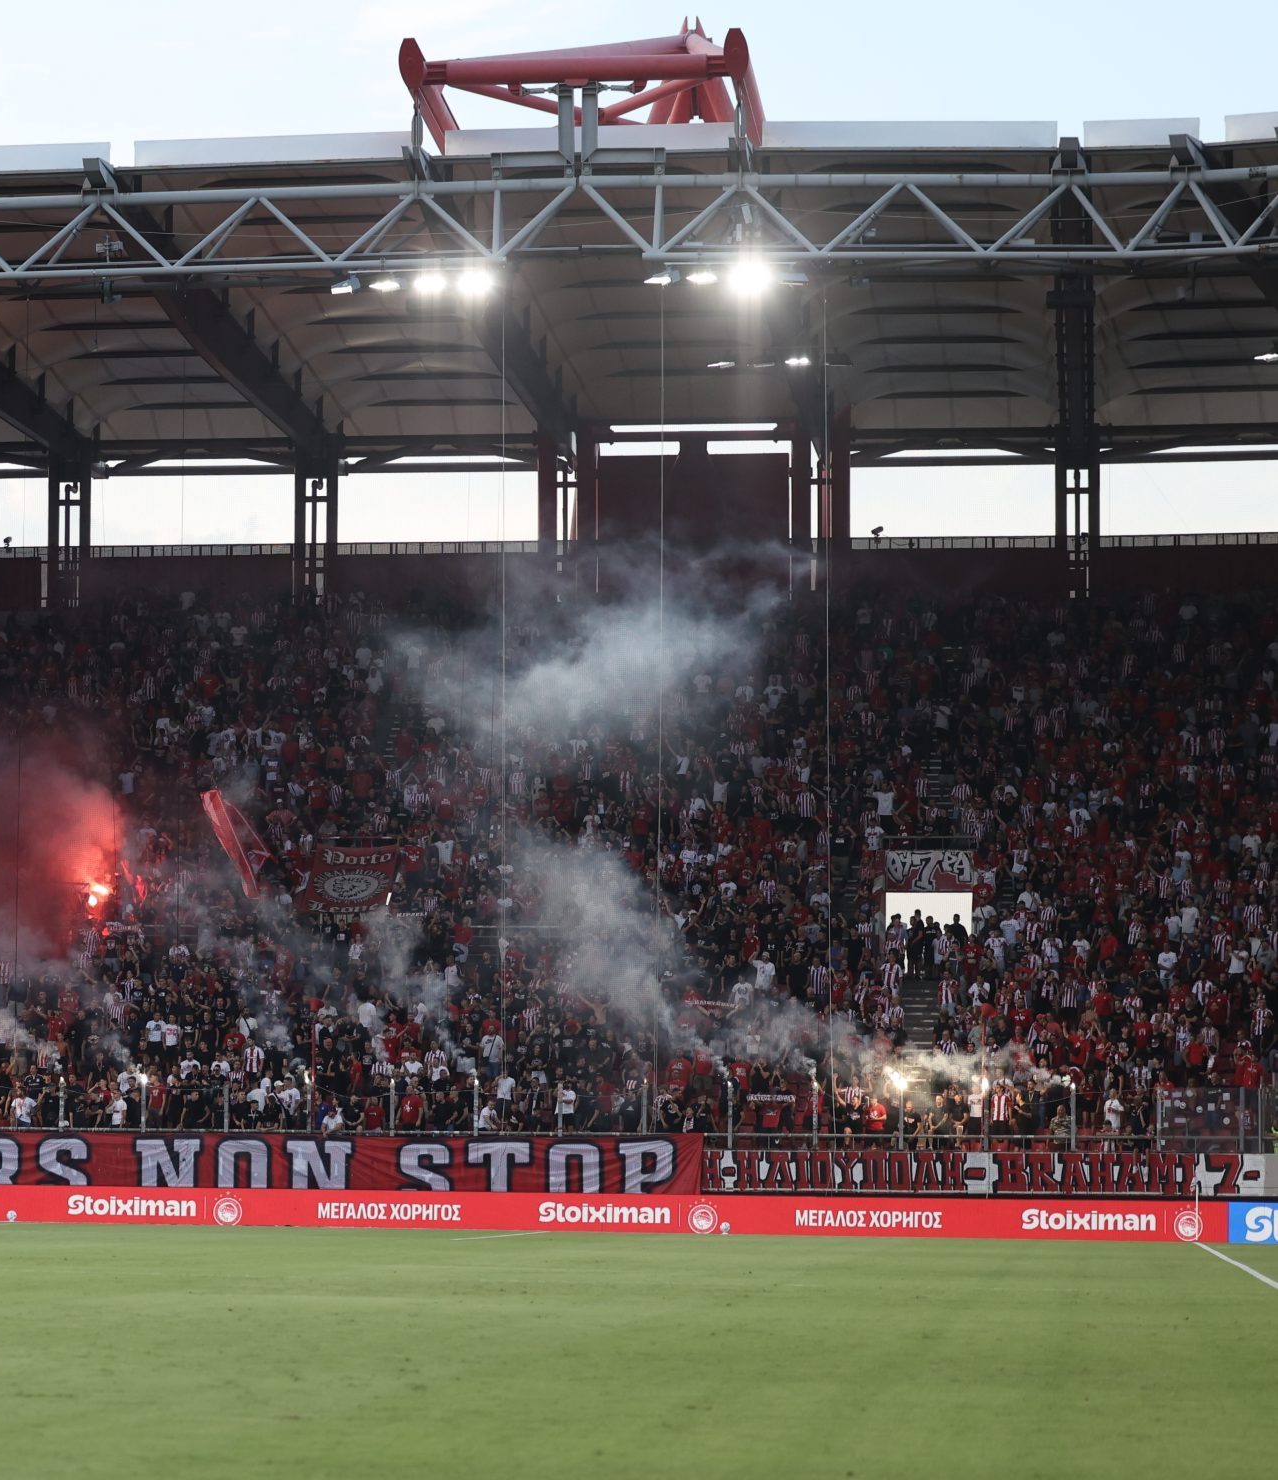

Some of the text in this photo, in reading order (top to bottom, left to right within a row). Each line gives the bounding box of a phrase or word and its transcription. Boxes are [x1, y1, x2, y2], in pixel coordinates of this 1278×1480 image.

[322, 848, 392, 865] Porto
[135, 1138, 353, 1190] NON
[399, 1140, 674, 1194] STOP
[67, 1194, 197, 1217] Stoiximan
[317, 1202, 461, 1221] ΜΕΓΑΛΟΣ ΧΟΡΗΓΟΣ
[538, 1201, 671, 1224] Stoiximan
[795, 1209, 943, 1229] ΜΕΓΑΛΟΣ ΧΟΡΗΓΟΣ
[1021, 1208, 1157, 1231] Stoiximan
